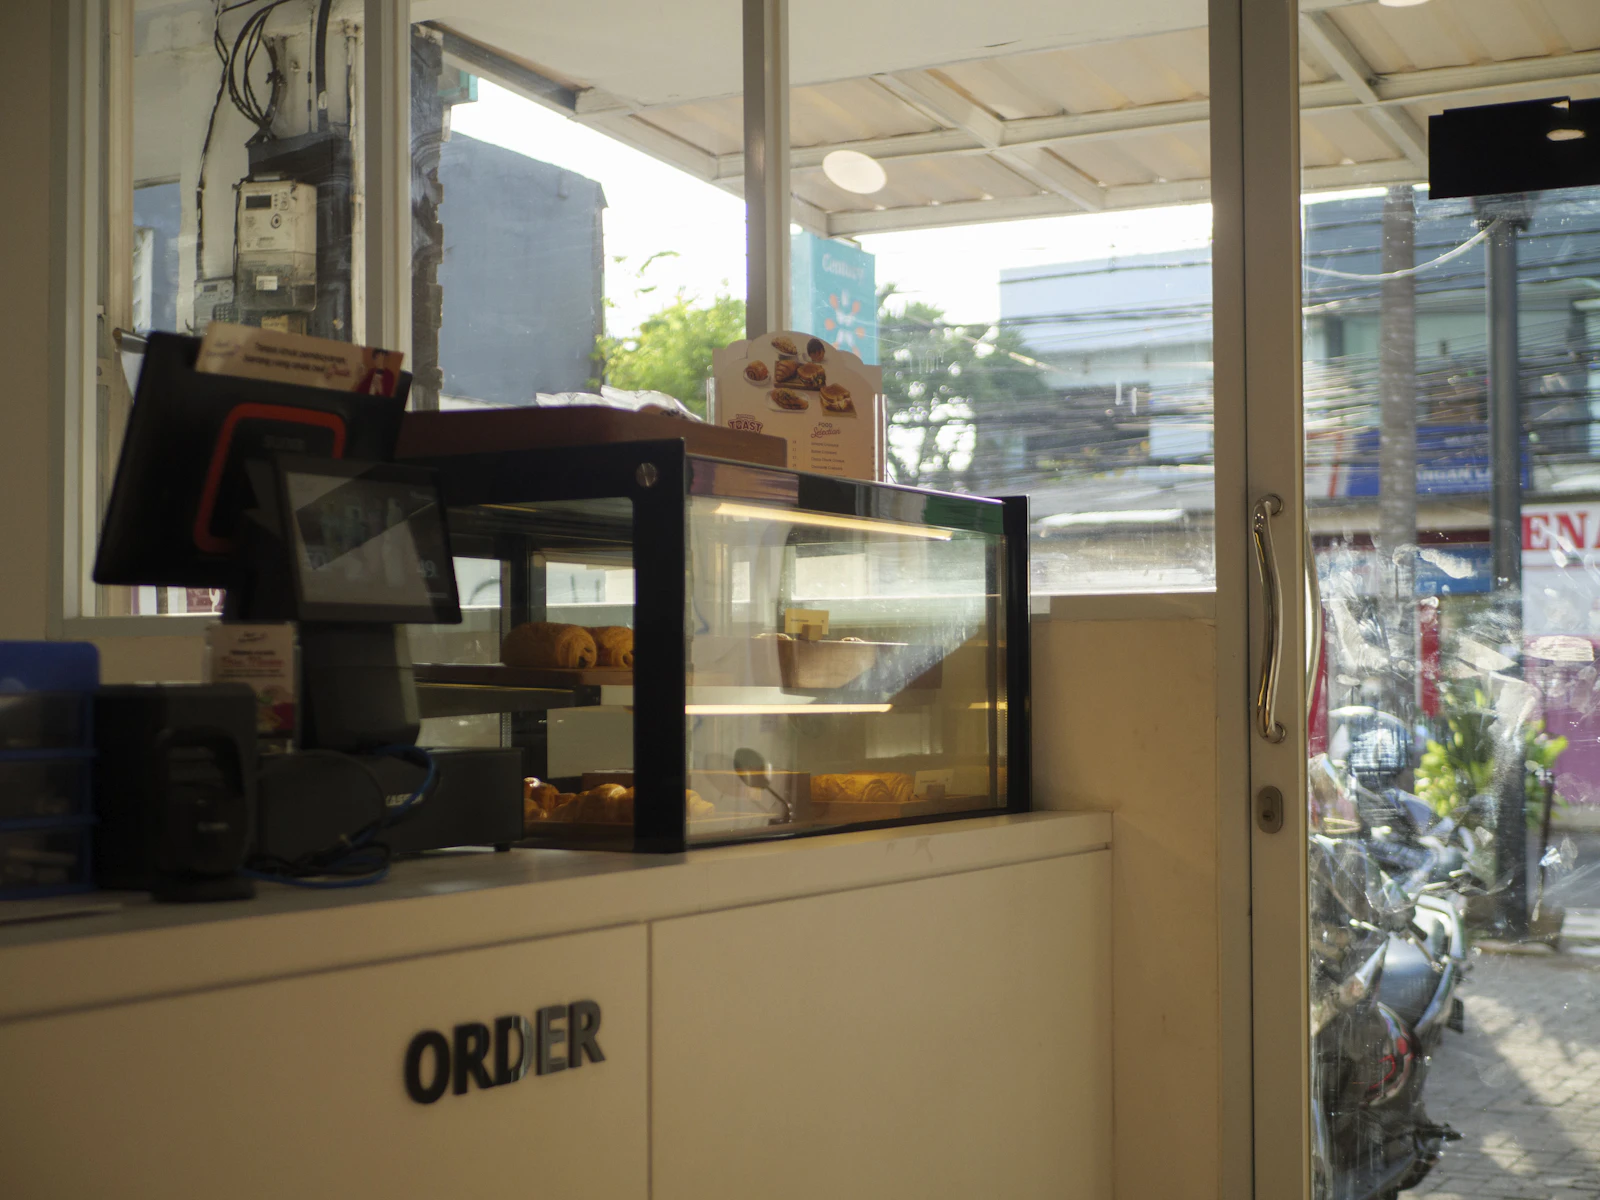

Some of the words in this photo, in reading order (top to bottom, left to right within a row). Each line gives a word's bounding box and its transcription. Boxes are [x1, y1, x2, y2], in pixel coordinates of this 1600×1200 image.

[729, 420, 762, 432] TOAST
[810, 426, 842, 438] Selection
[1521, 511, 1600, 551] EN
[403, 998, 607, 1105] ORDER
